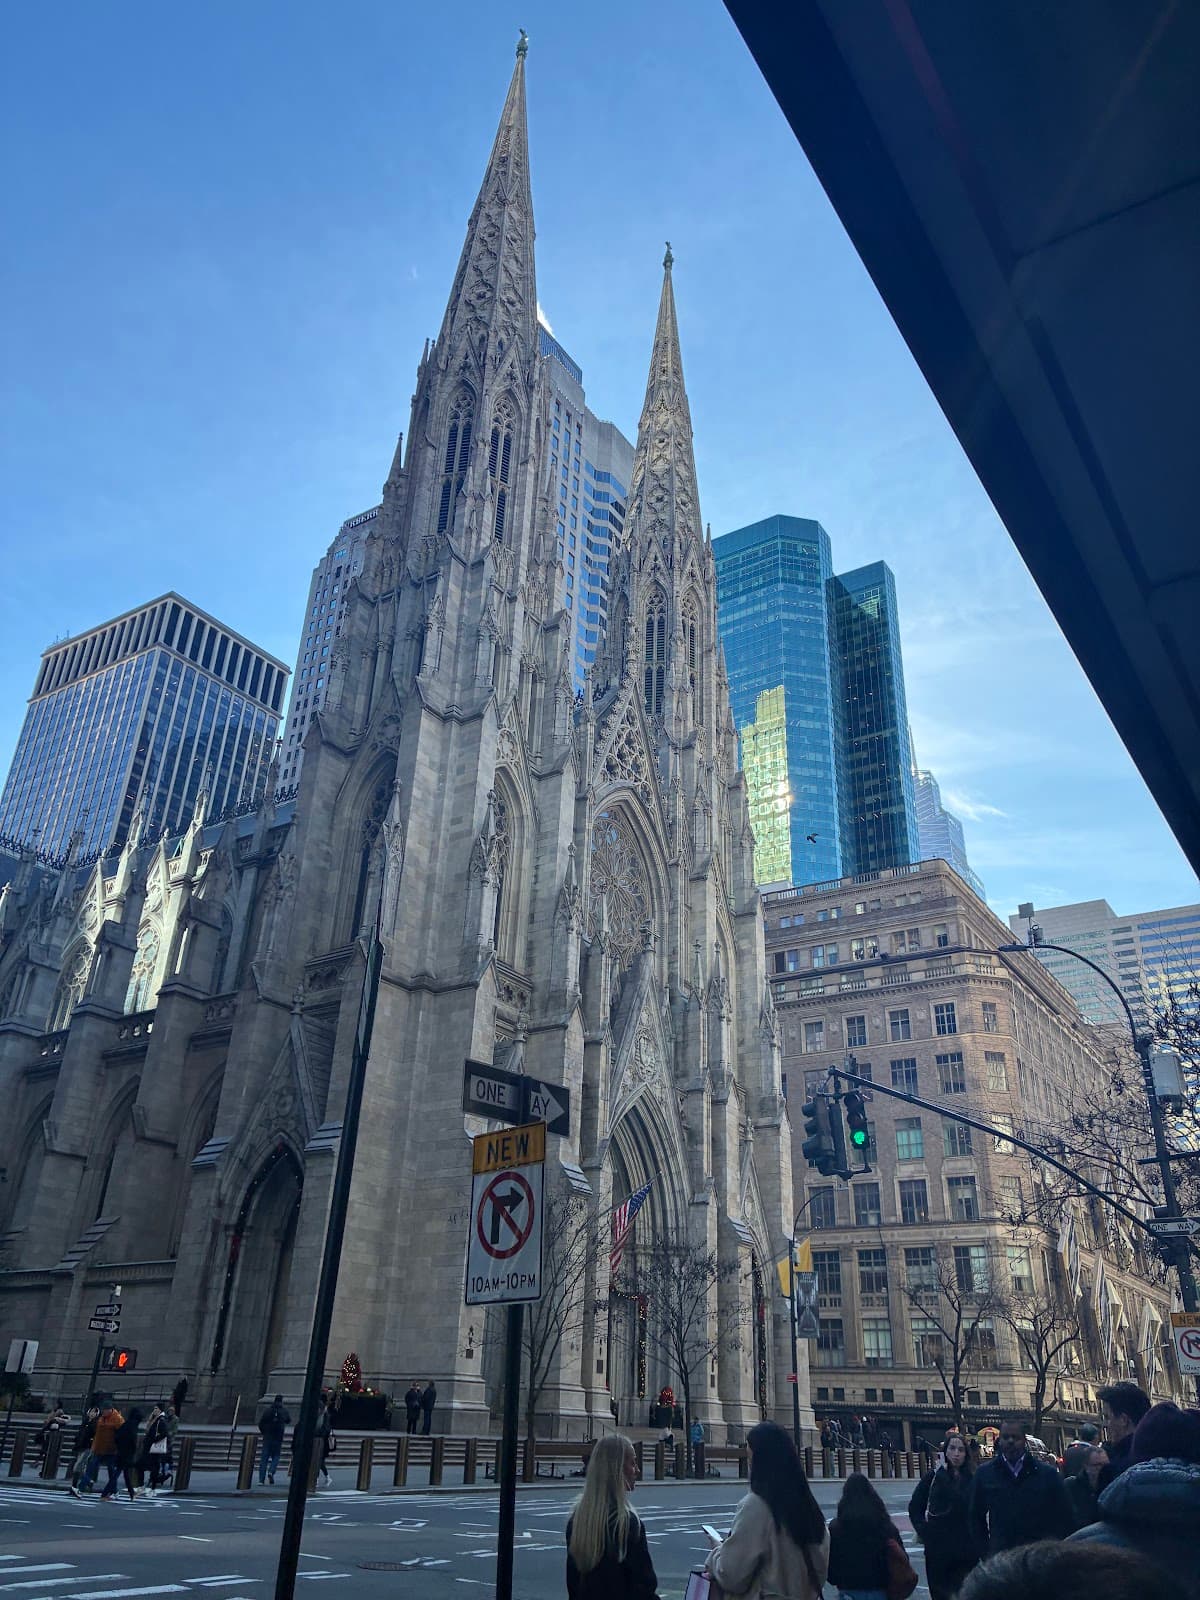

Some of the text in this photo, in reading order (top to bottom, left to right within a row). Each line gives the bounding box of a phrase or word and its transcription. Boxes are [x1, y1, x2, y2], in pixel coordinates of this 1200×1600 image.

[476, 1079, 550, 1116] ONE AY
[487, 1133, 529, 1165] NEW
[1151, 1222, 1195, 1231] ONE WAY
[471, 1272, 537, 1294] 10AM-10PM
